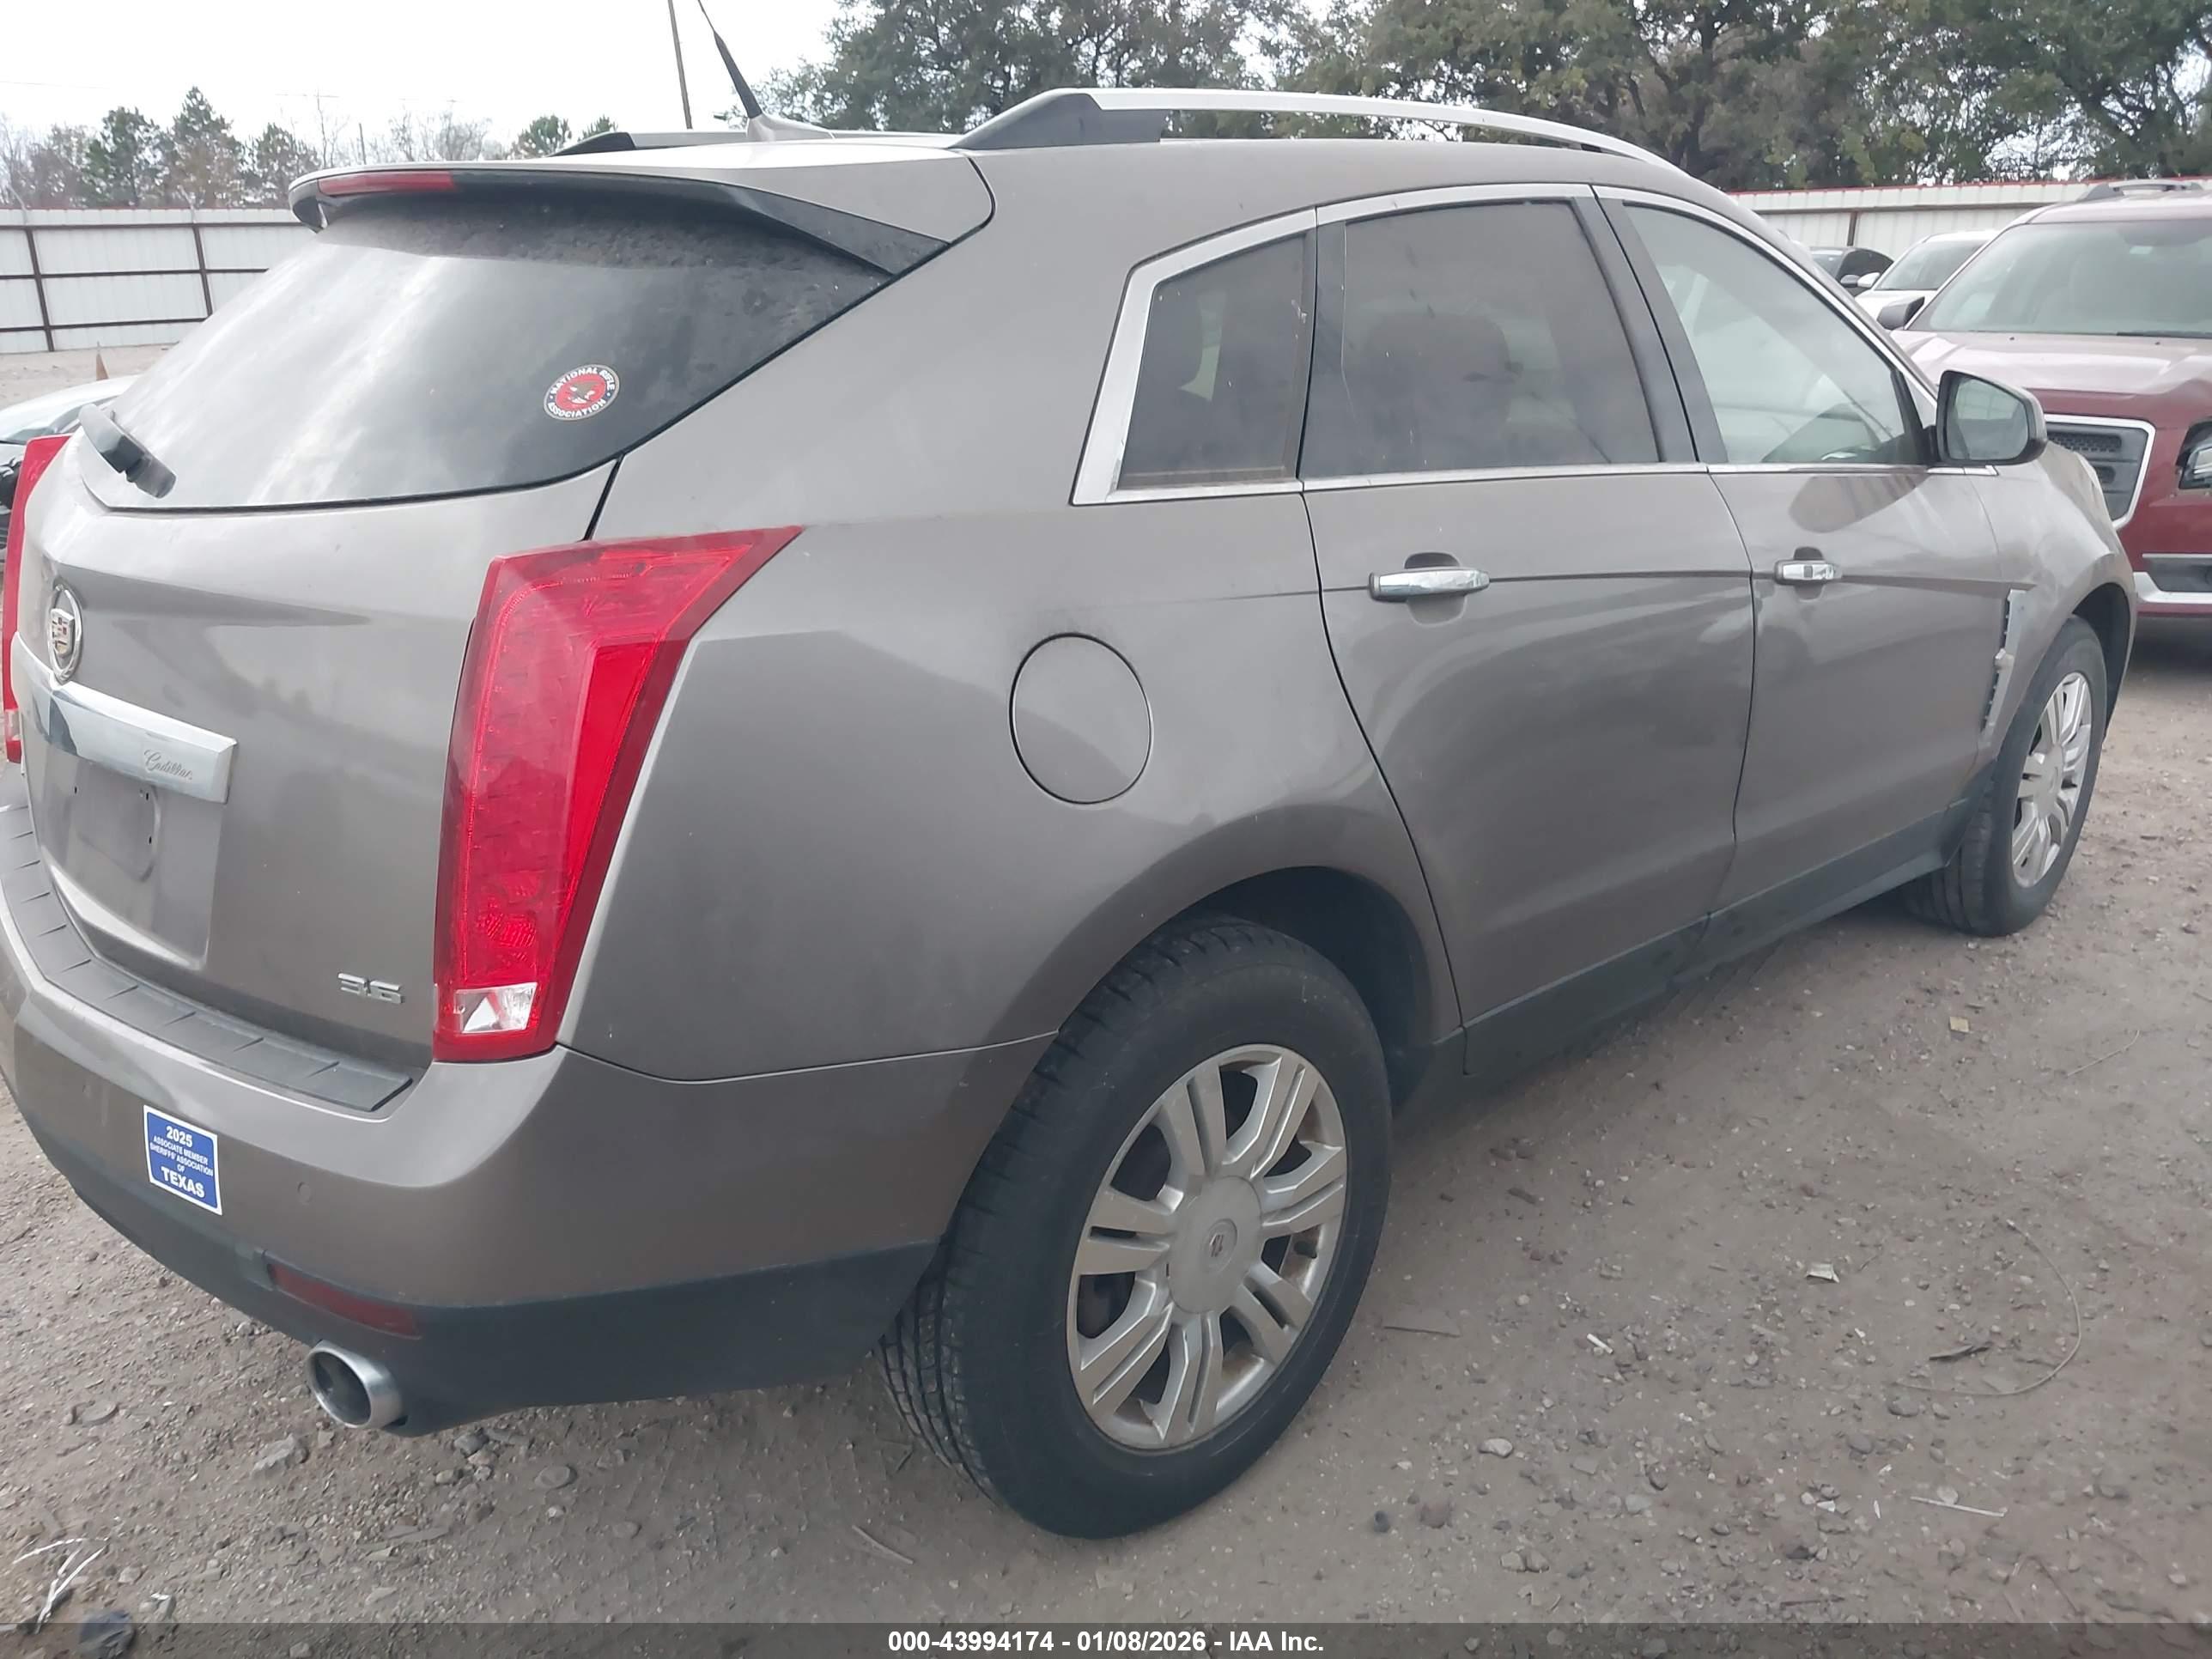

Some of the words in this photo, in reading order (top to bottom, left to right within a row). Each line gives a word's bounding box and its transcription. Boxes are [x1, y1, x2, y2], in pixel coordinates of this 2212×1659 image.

[550, 367, 599, 395] NATIONAL
[599, 369, 616, 391] RIFLE
[548, 398, 606, 417] ASSOCIATION
[166, 1125, 193, 1148] 2025
[153, 1135, 183, 1156] ASSOCIATE
[183, 1148, 209, 1166] MEMBER
[176, 1155, 214, 1177] ASSOCIATION
[177, 1164, 185, 1174] OF
[161, 1165, 205, 1199] TEXAS
